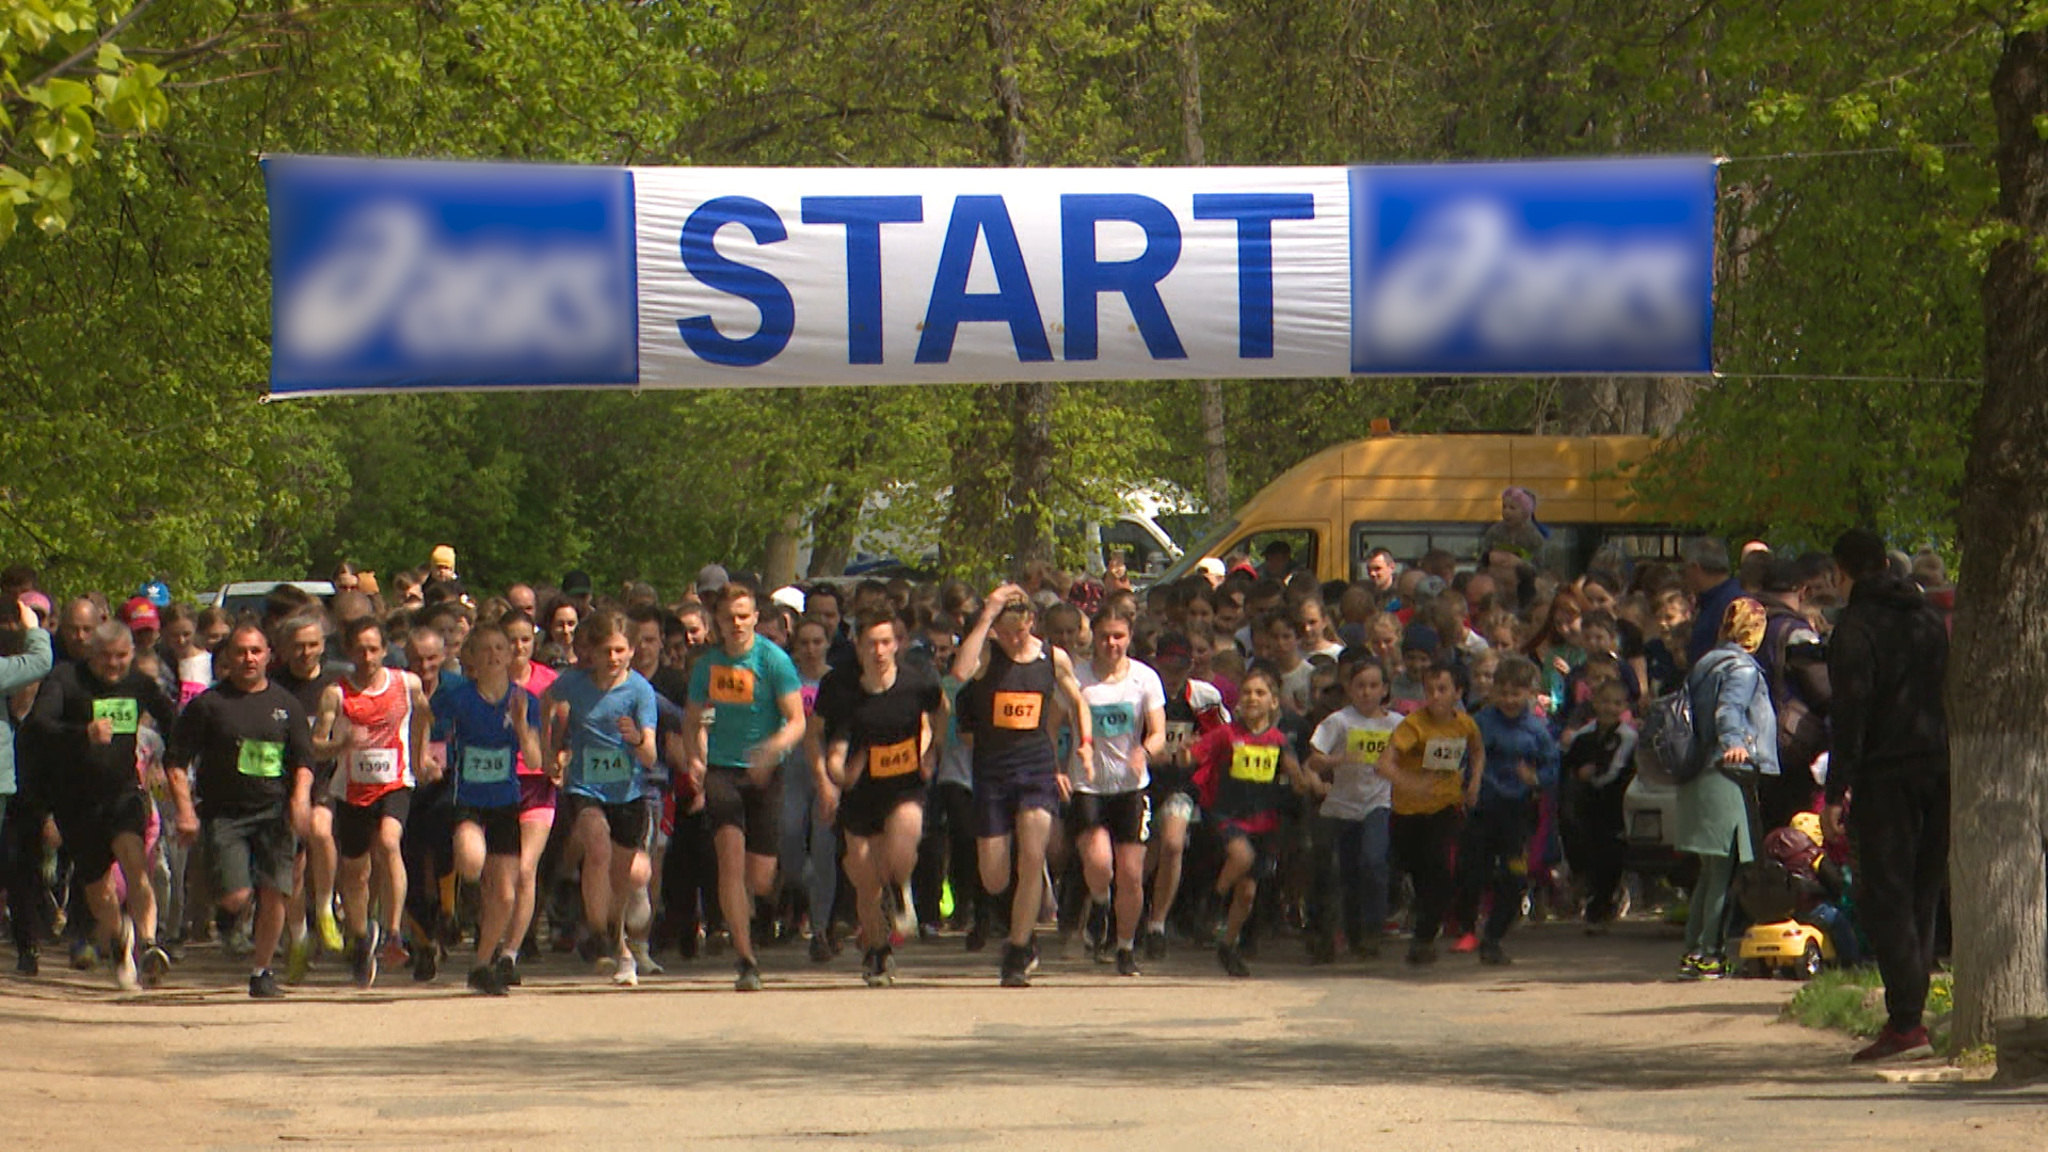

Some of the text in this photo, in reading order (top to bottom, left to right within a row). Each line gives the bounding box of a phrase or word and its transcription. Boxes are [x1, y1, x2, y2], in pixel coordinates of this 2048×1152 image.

[676, 194, 1315, 367] START
[1003, 703, 1034, 717] 867
[359, 761, 391, 772] 1399
[591, 757, 621, 770] 714
